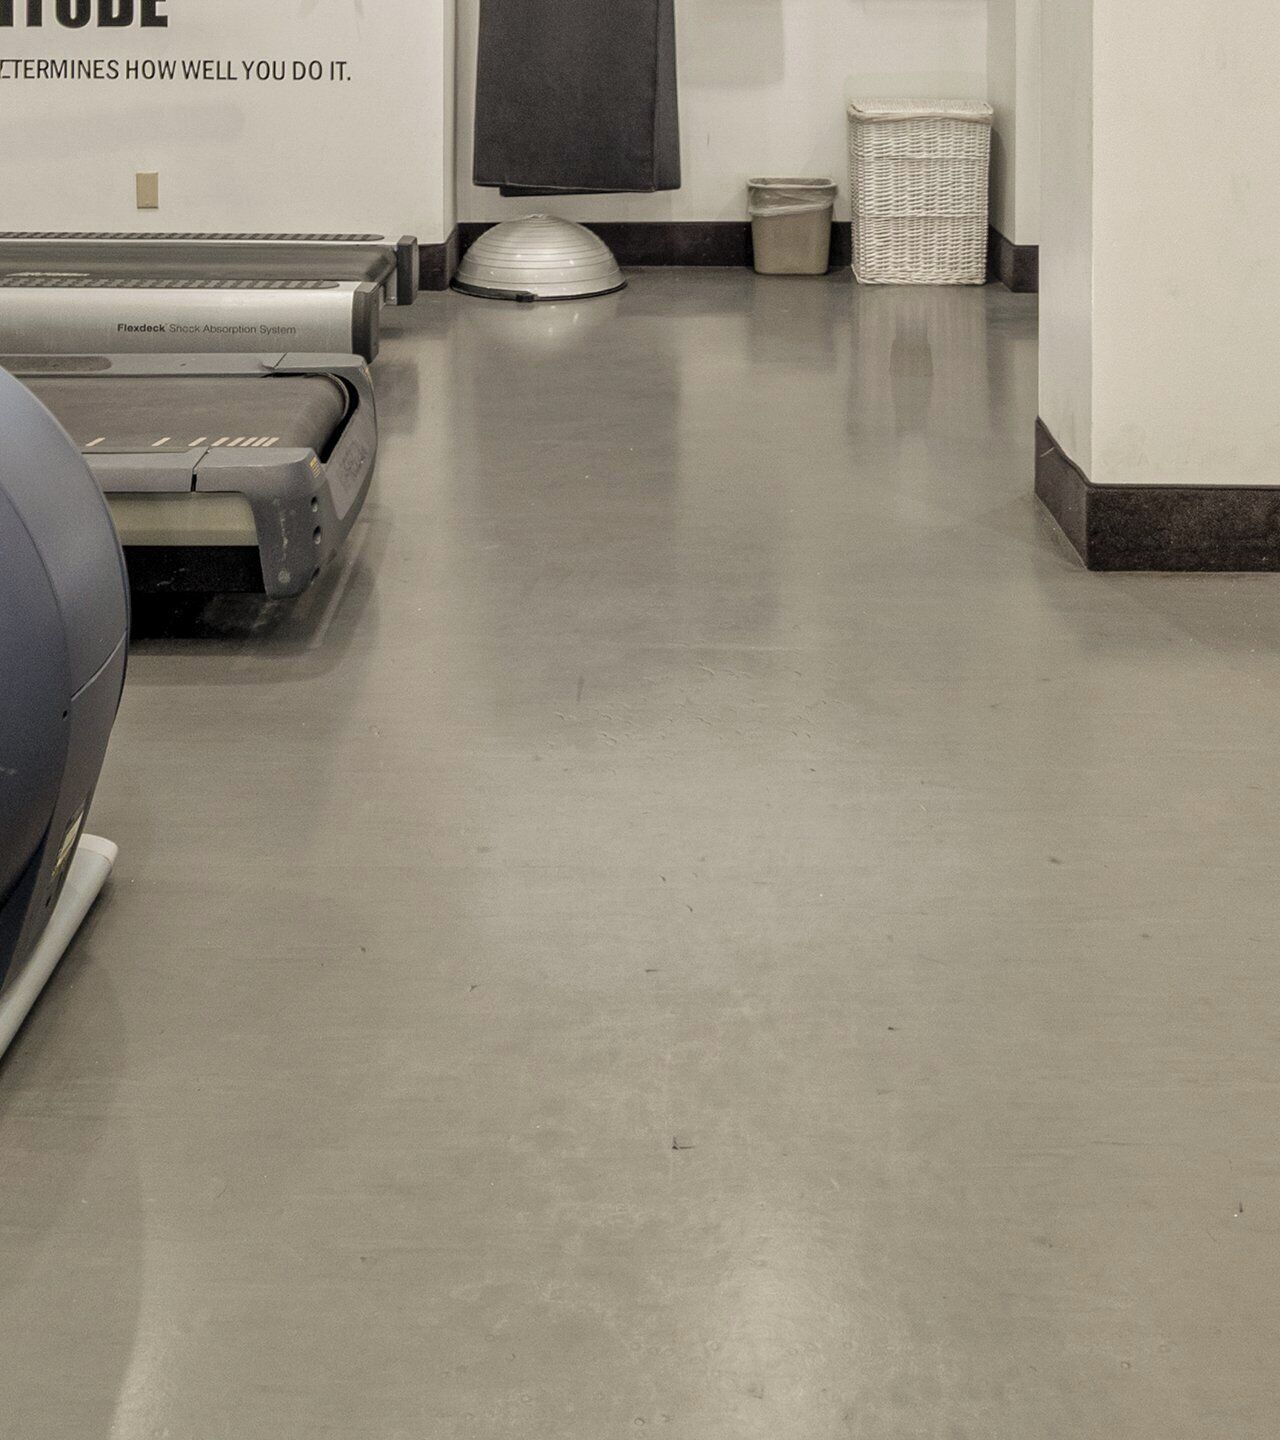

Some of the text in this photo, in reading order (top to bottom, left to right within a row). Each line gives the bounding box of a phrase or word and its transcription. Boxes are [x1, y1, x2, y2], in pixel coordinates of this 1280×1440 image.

[126, 59, 177, 80] HOW
[181, 60, 238, 81] WELL
[241, 60, 285, 81] YOU
[292, 60, 323, 81] DO
[330, 61, 351, 81] IT.
[117, 323, 297, 337] Flexdeck Shock Absorption System
